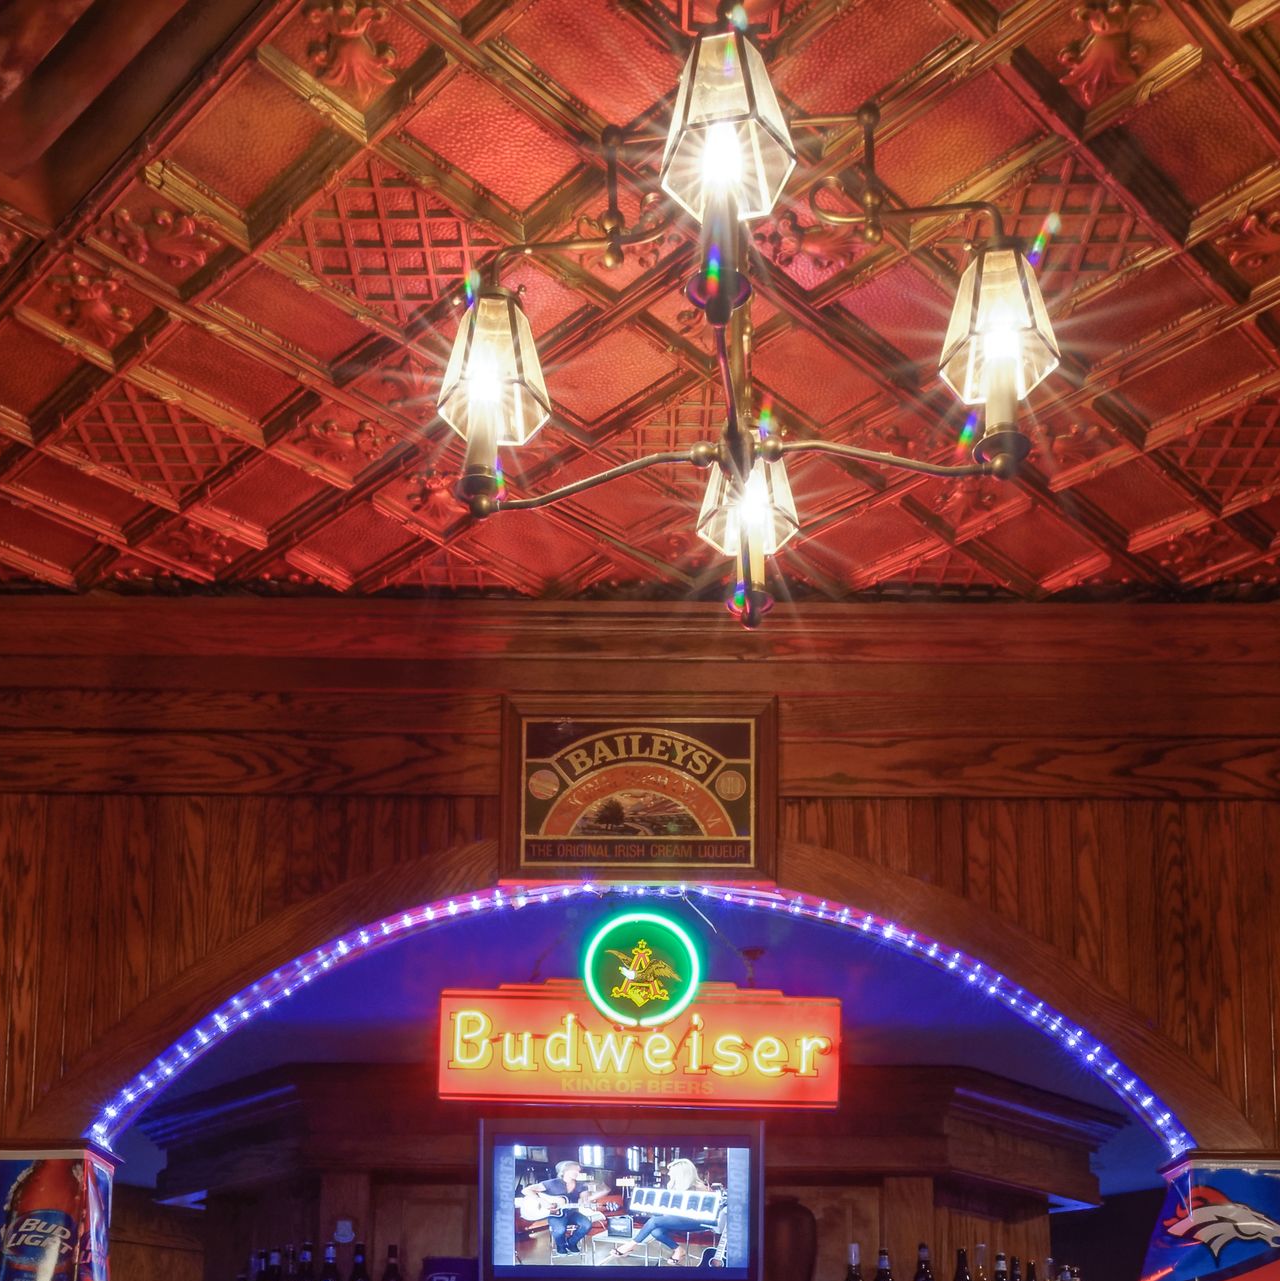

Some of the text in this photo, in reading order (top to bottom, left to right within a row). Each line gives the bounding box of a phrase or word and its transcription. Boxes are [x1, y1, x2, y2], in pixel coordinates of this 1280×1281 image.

[565, 735, 713, 776] BAILEYS
[529, 843, 745, 858] THE ORIGINAL IRISH CREAM LIQUEUR
[448, 1010, 833, 1077] Budweiser
[561, 1077, 714, 1095] KING OF BEERS
[18, 1218, 72, 1240] BUD
